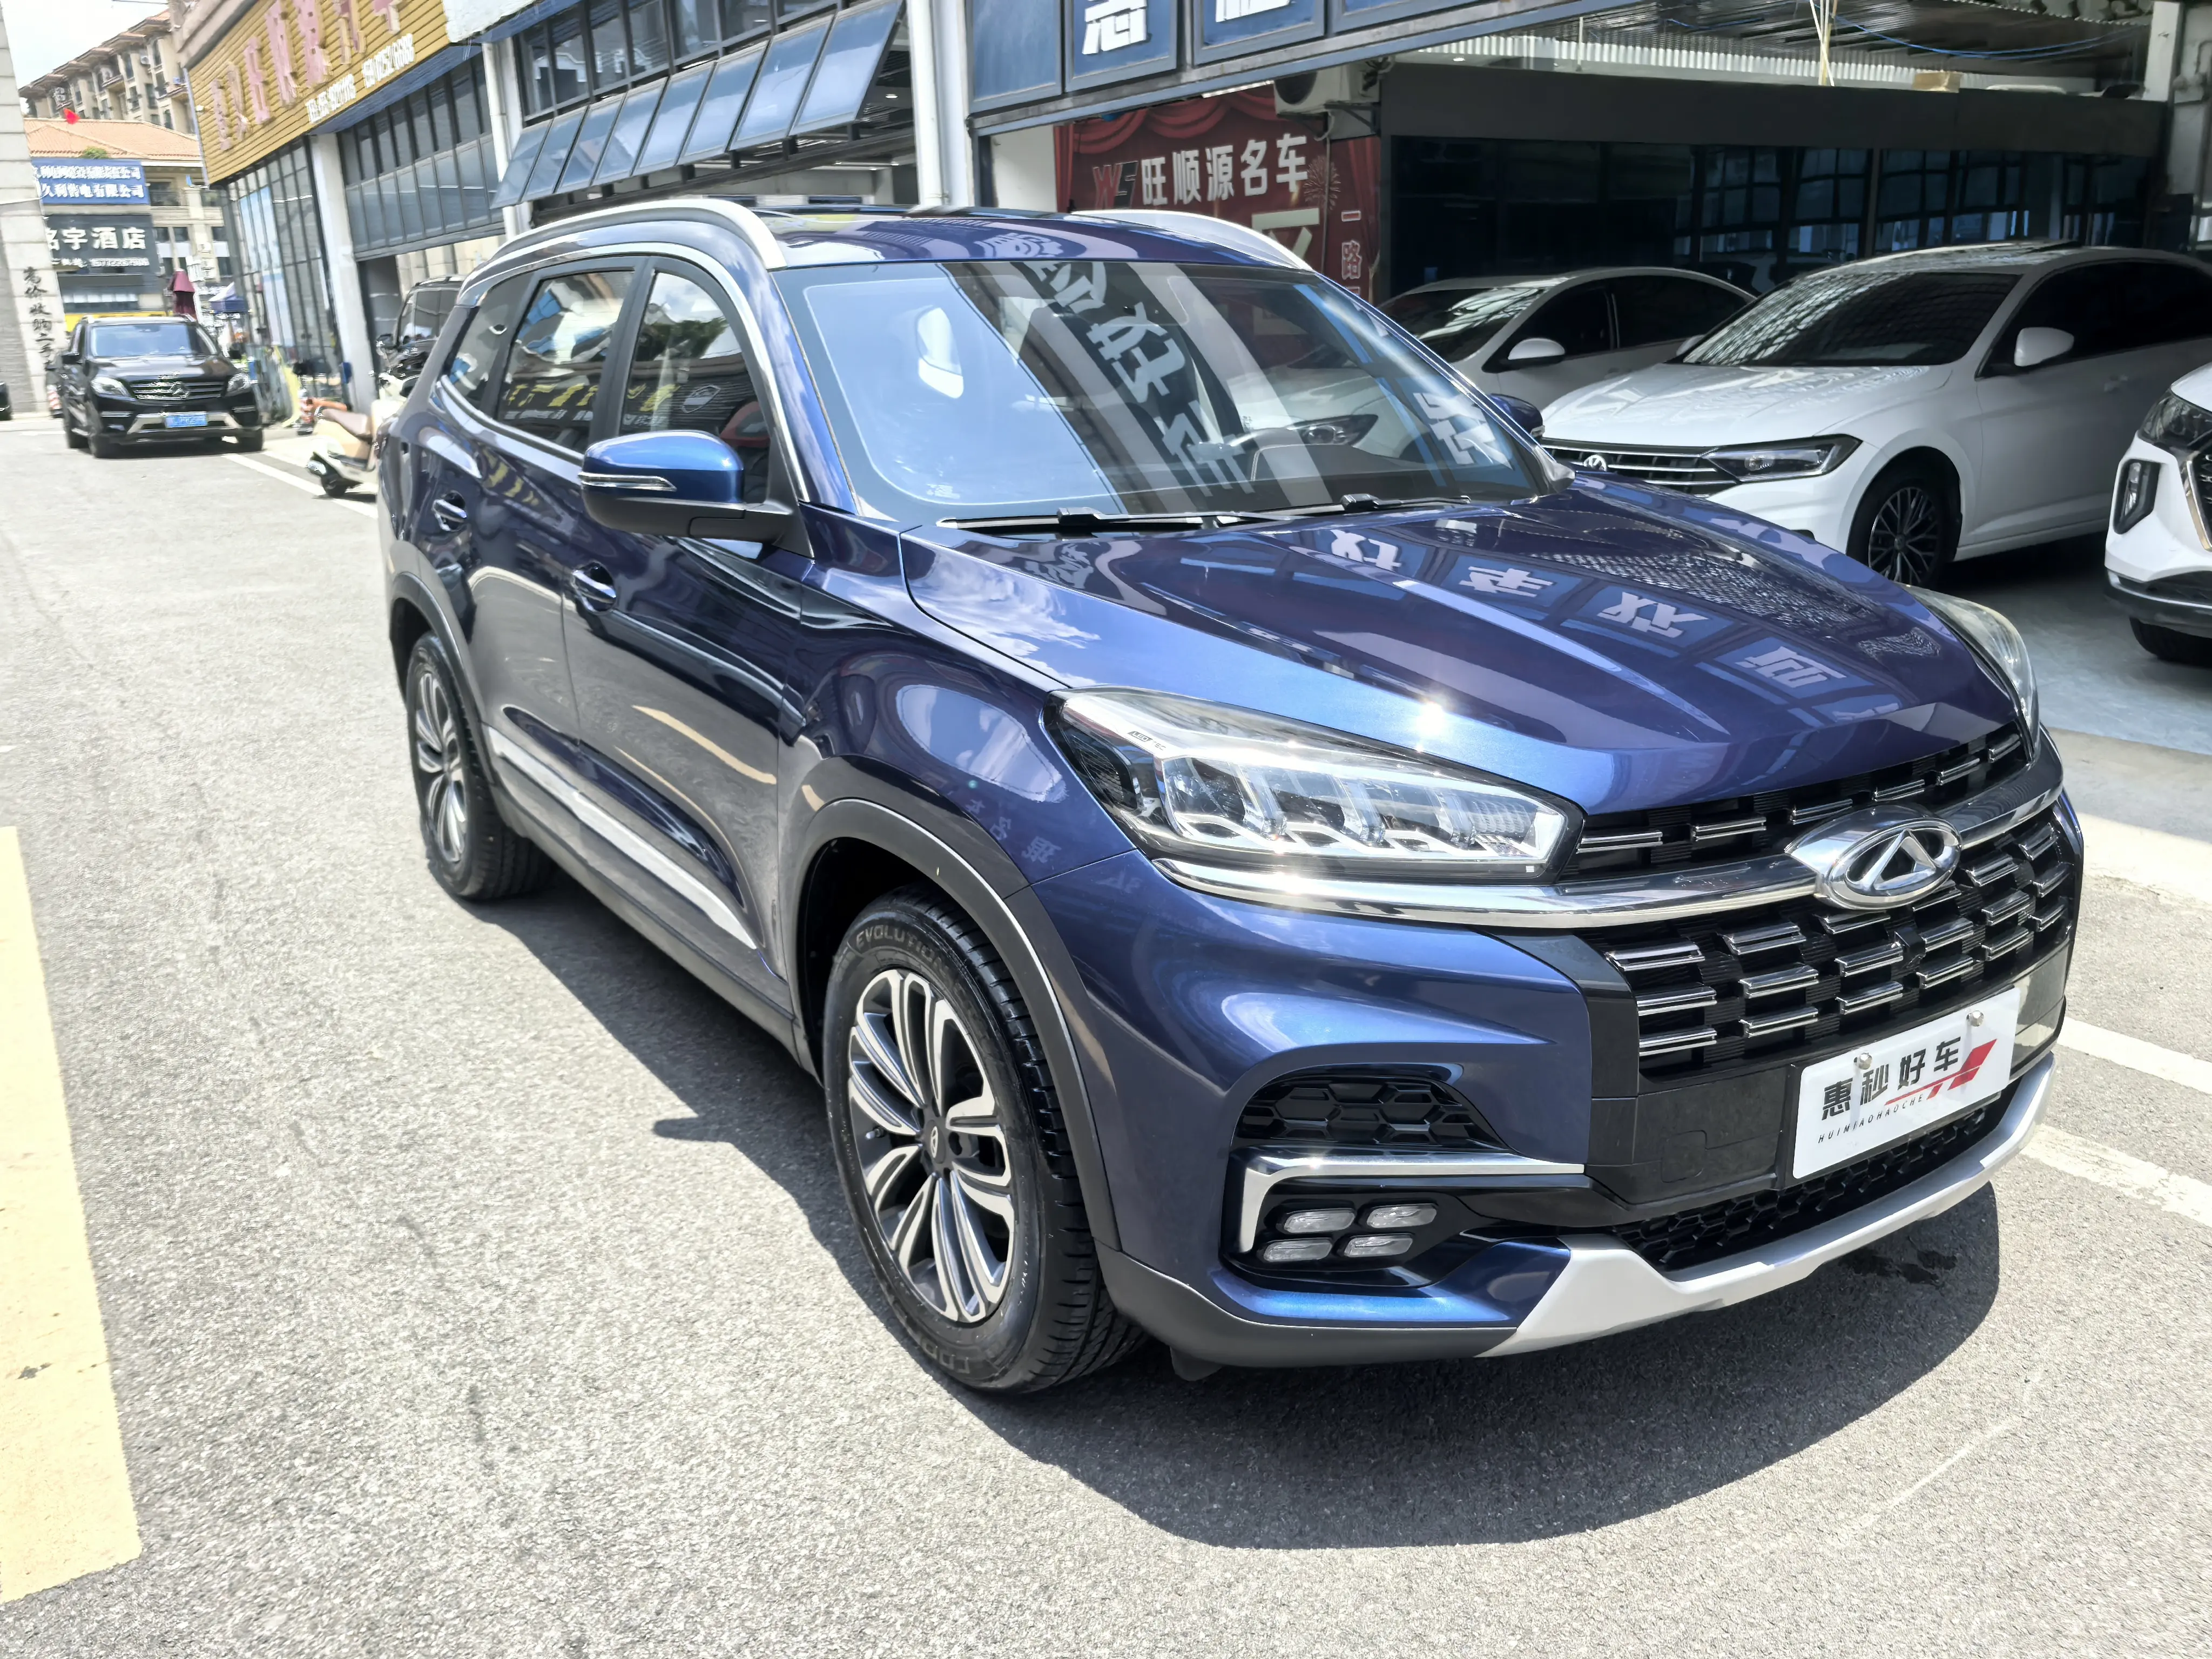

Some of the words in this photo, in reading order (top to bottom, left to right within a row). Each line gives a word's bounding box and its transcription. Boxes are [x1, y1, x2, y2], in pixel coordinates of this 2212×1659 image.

[1141, 133, 1308, 206] 旺顺源名车
[1341, 210, 1362, 294] 一路
[1821, 1036, 1961, 1121] 惠秒好车
[1818, 1094, 1924, 1144] HUIMIAOHAOCHE
